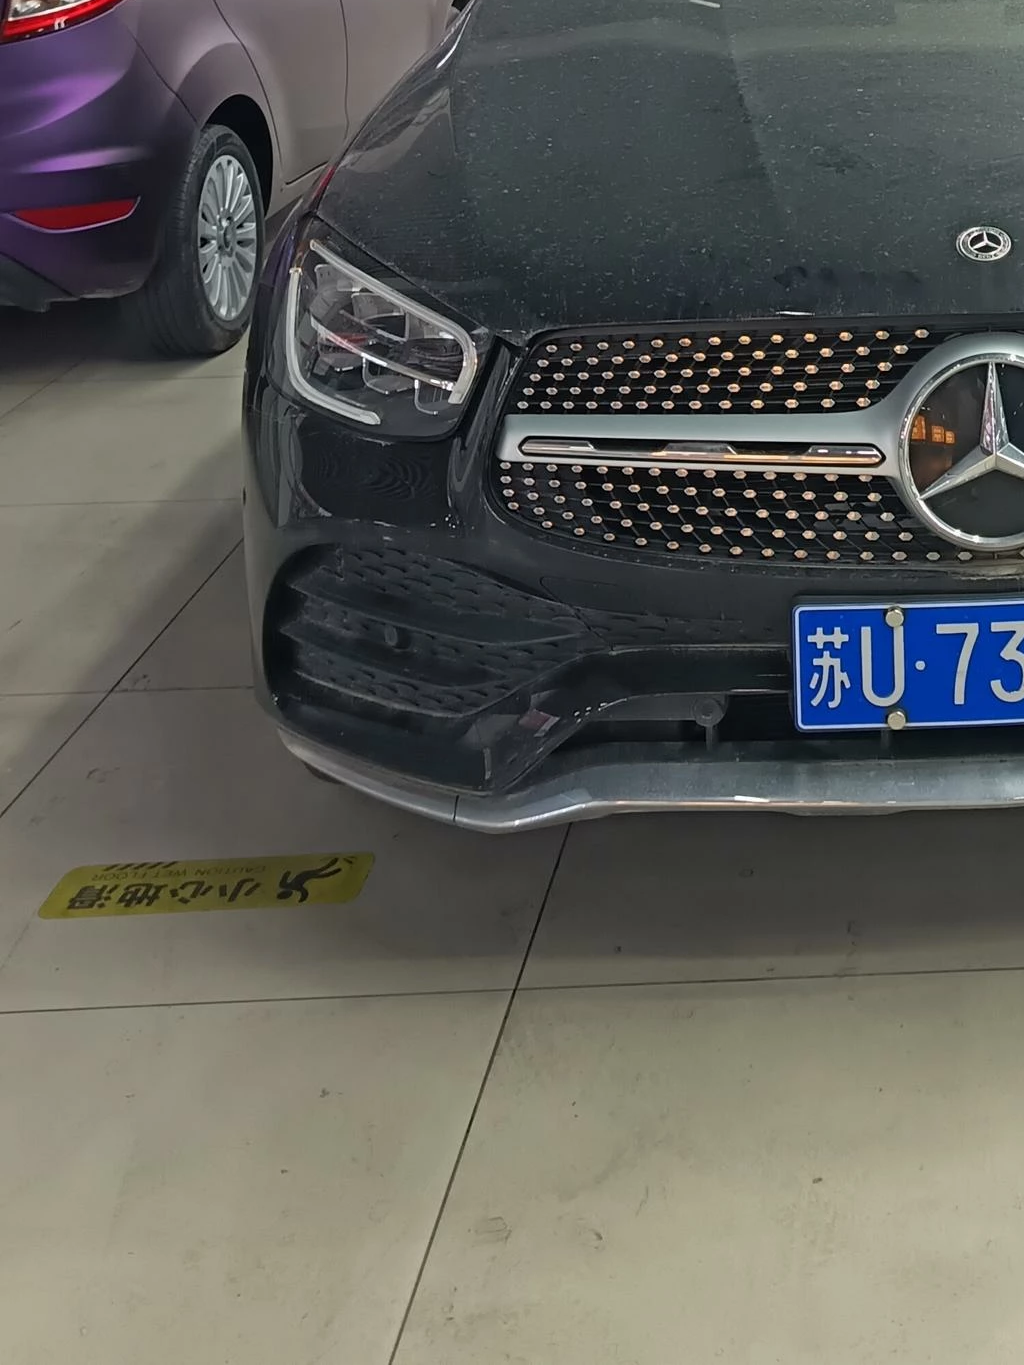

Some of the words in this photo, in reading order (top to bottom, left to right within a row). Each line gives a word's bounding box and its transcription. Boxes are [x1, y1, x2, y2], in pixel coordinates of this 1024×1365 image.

[91, 870, 147, 881] FLOOR
[153, 867, 191, 878] WET
[195, 865, 267, 876] CAUTION
[66, 877, 263, 911] 小心地滑
